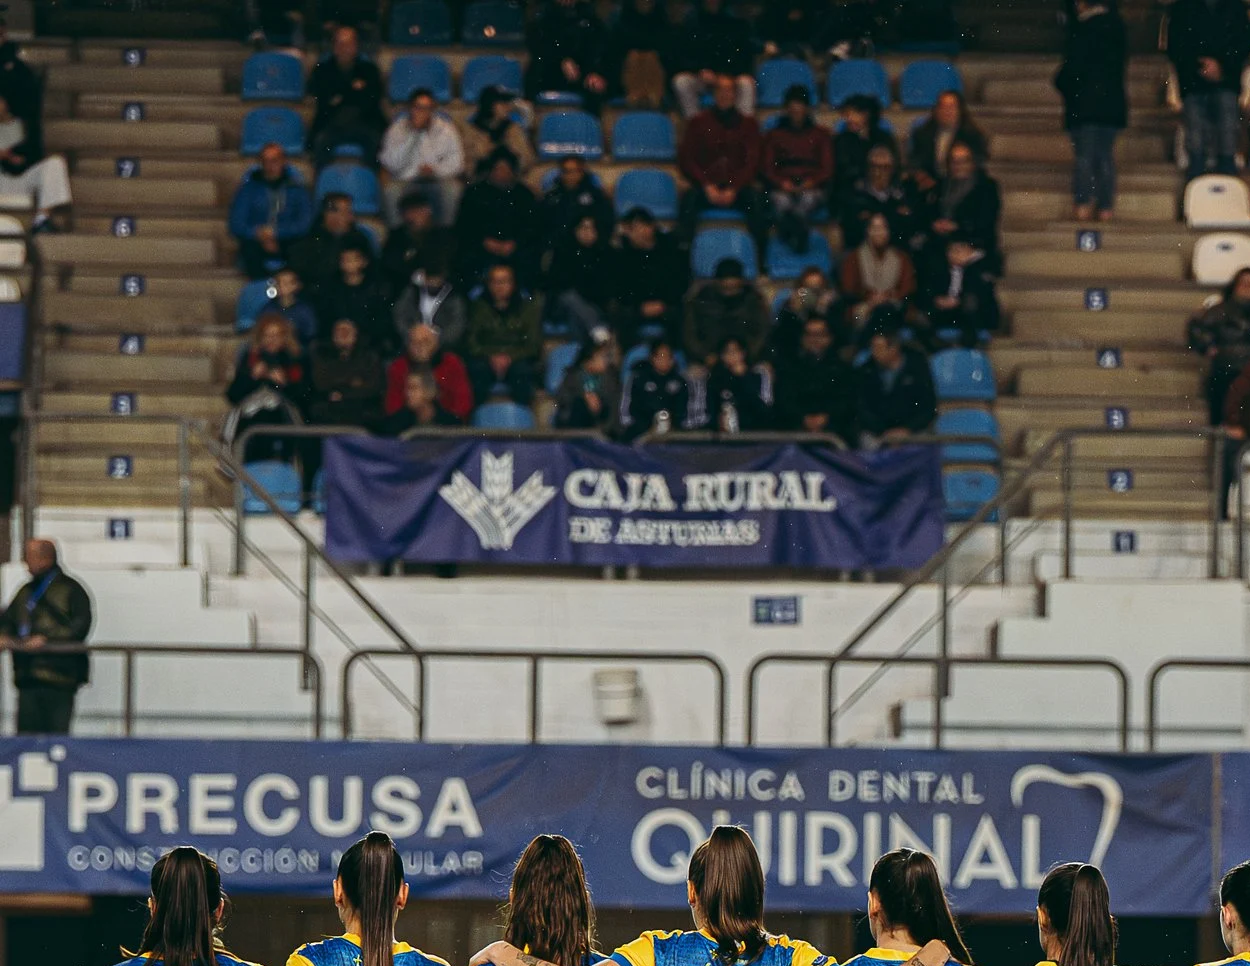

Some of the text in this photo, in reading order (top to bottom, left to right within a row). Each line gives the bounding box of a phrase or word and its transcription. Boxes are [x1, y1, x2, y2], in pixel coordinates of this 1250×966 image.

[563, 468, 837, 513] CAJA RURAL
[569, 517, 761, 546] DE ASTURIAS
[67, 770, 484, 839] PRECUSA
[635, 761, 985, 806] CLÍNICA DENTAL
